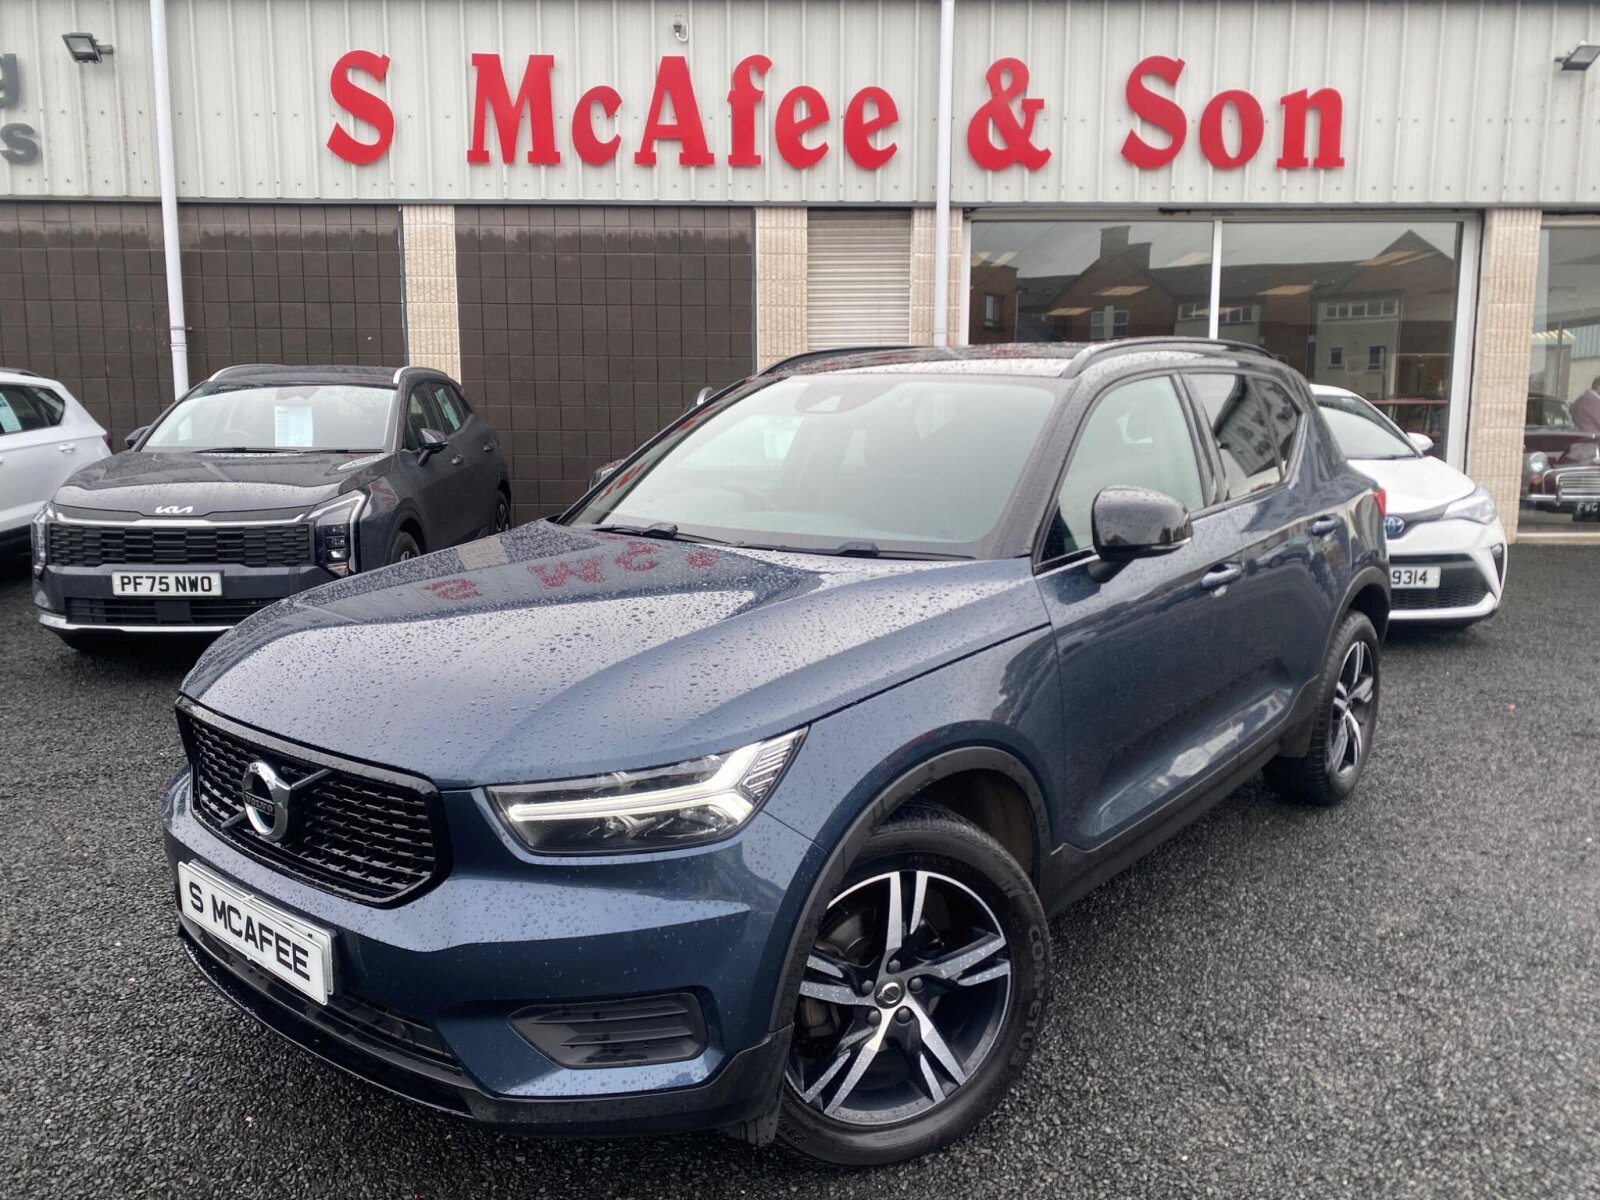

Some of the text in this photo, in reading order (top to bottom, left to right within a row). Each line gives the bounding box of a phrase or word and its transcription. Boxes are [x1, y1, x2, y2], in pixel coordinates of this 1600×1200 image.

[327, 51, 1346, 171] S McAfee & Son
[120, 575, 212, 592] PF75 NWO
[1392, 569, 1429, 585] 9314
[244, 794, 274, 813] VOLVO
[189, 881, 311, 982] S MCAFEE
